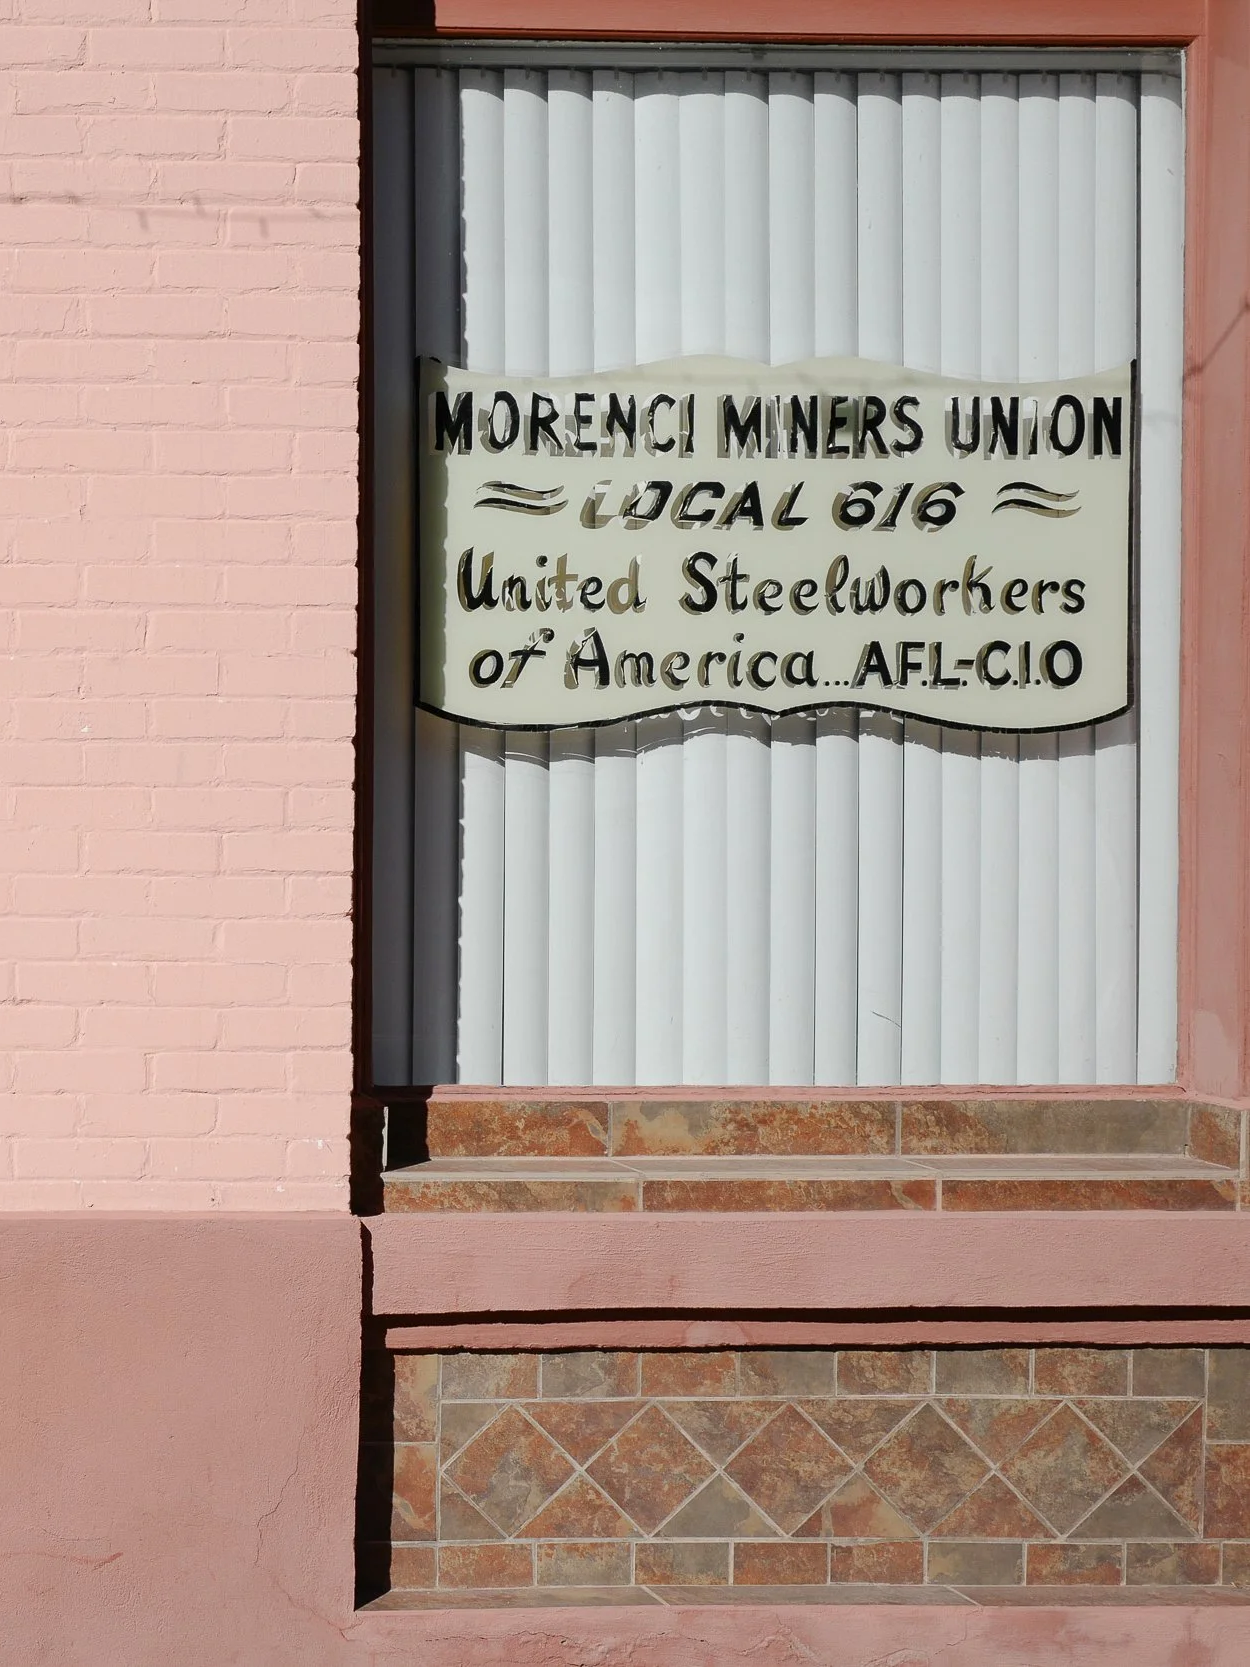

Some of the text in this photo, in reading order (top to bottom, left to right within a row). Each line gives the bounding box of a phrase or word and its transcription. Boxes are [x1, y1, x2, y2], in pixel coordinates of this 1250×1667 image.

[432, 390, 1123, 459] MORENCI MINERS UNION
[579, 480, 965, 532] LOCAL 616
[456, 547, 1086, 616] United Steelworkers
[469, 627, 555, 689] of
